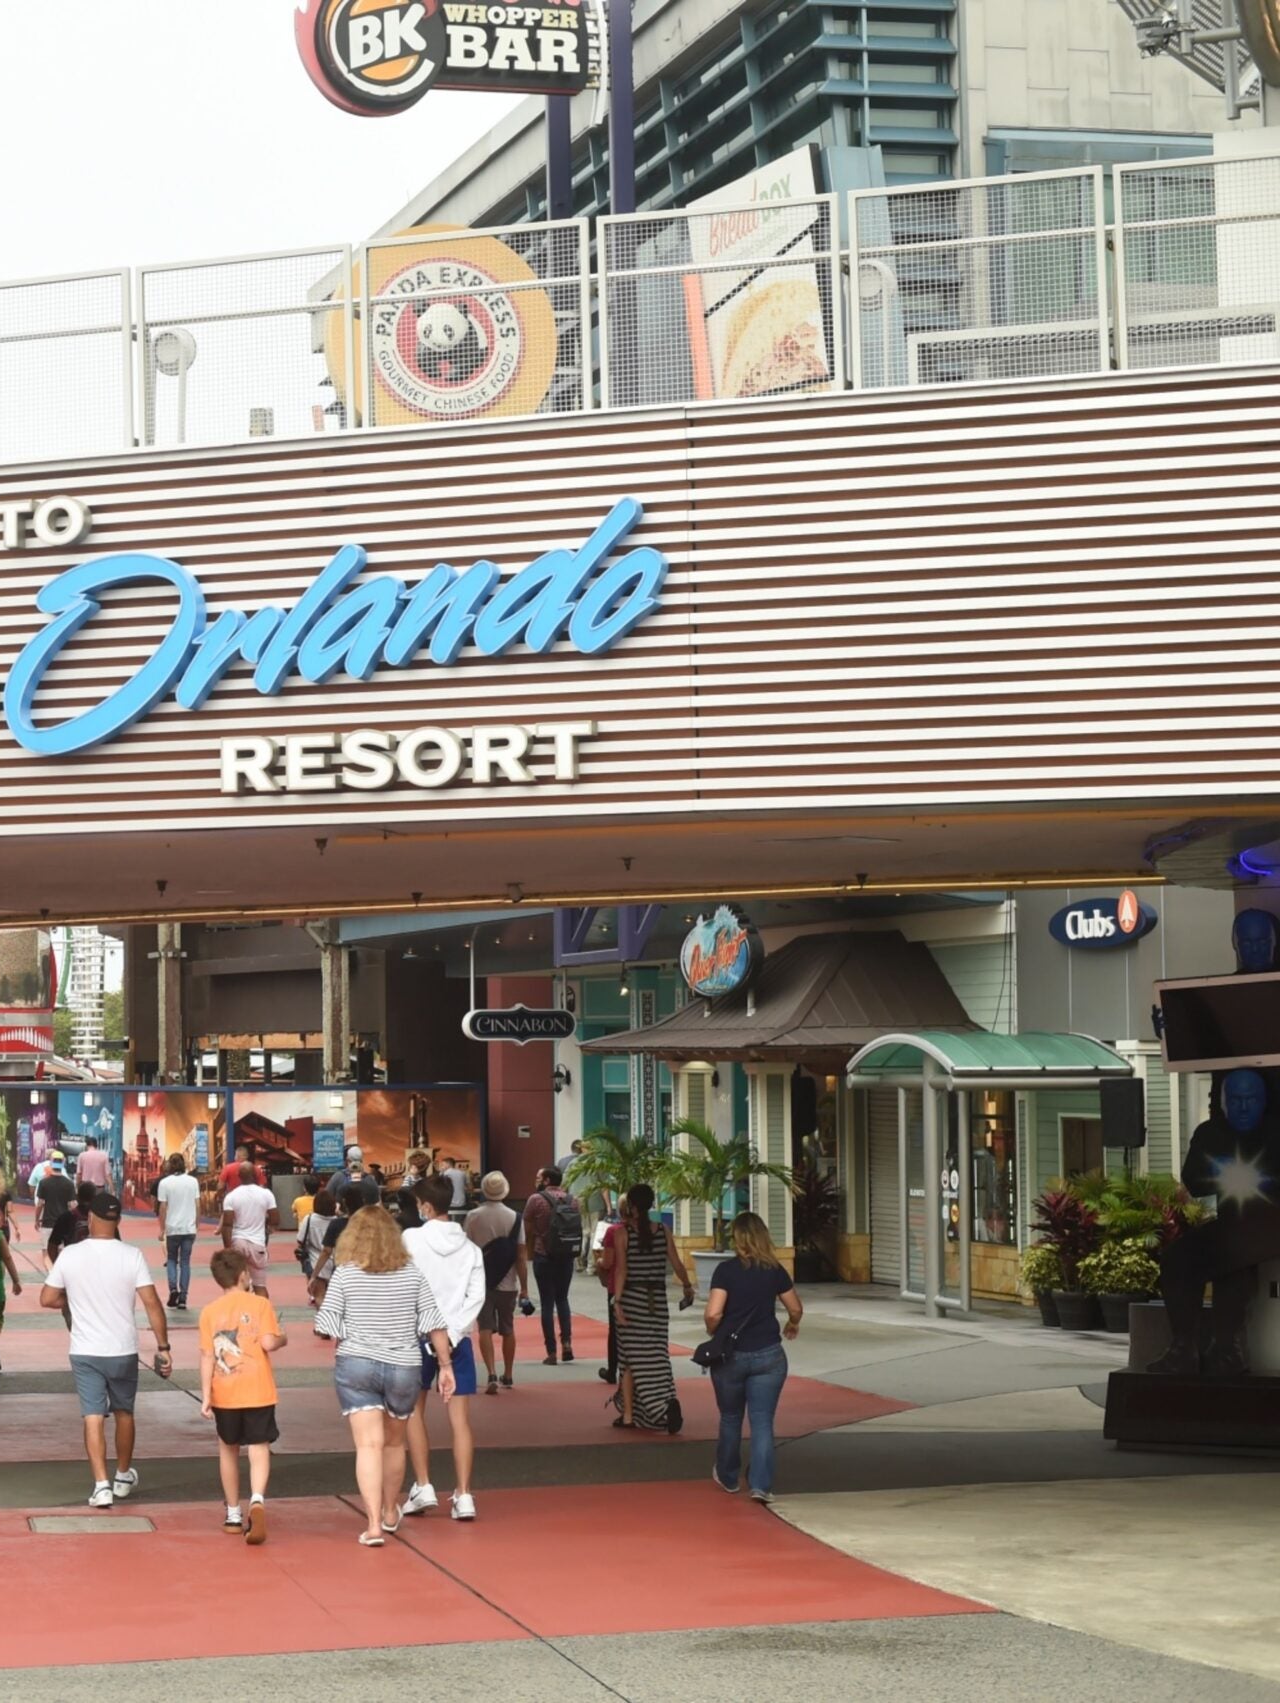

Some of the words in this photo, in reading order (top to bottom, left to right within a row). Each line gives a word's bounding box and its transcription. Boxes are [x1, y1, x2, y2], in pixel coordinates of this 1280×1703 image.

[348, 3, 427, 70] BK
[442, 4, 579, 29] WHOPPER
[445, 25, 581, 73] BAR
[439, 266, 516, 338] EXPESS
[378, 350, 428, 402] GOURMET
[434, 387, 490, 409] CHINESE
[491, 353, 514, 388] FOOD
[3, 495, 670, 757] Orlando
[220, 720, 597, 793] RESORT
[1065, 908, 1116, 940] Clubs
[476, 1016, 567, 1034] CINNABON
